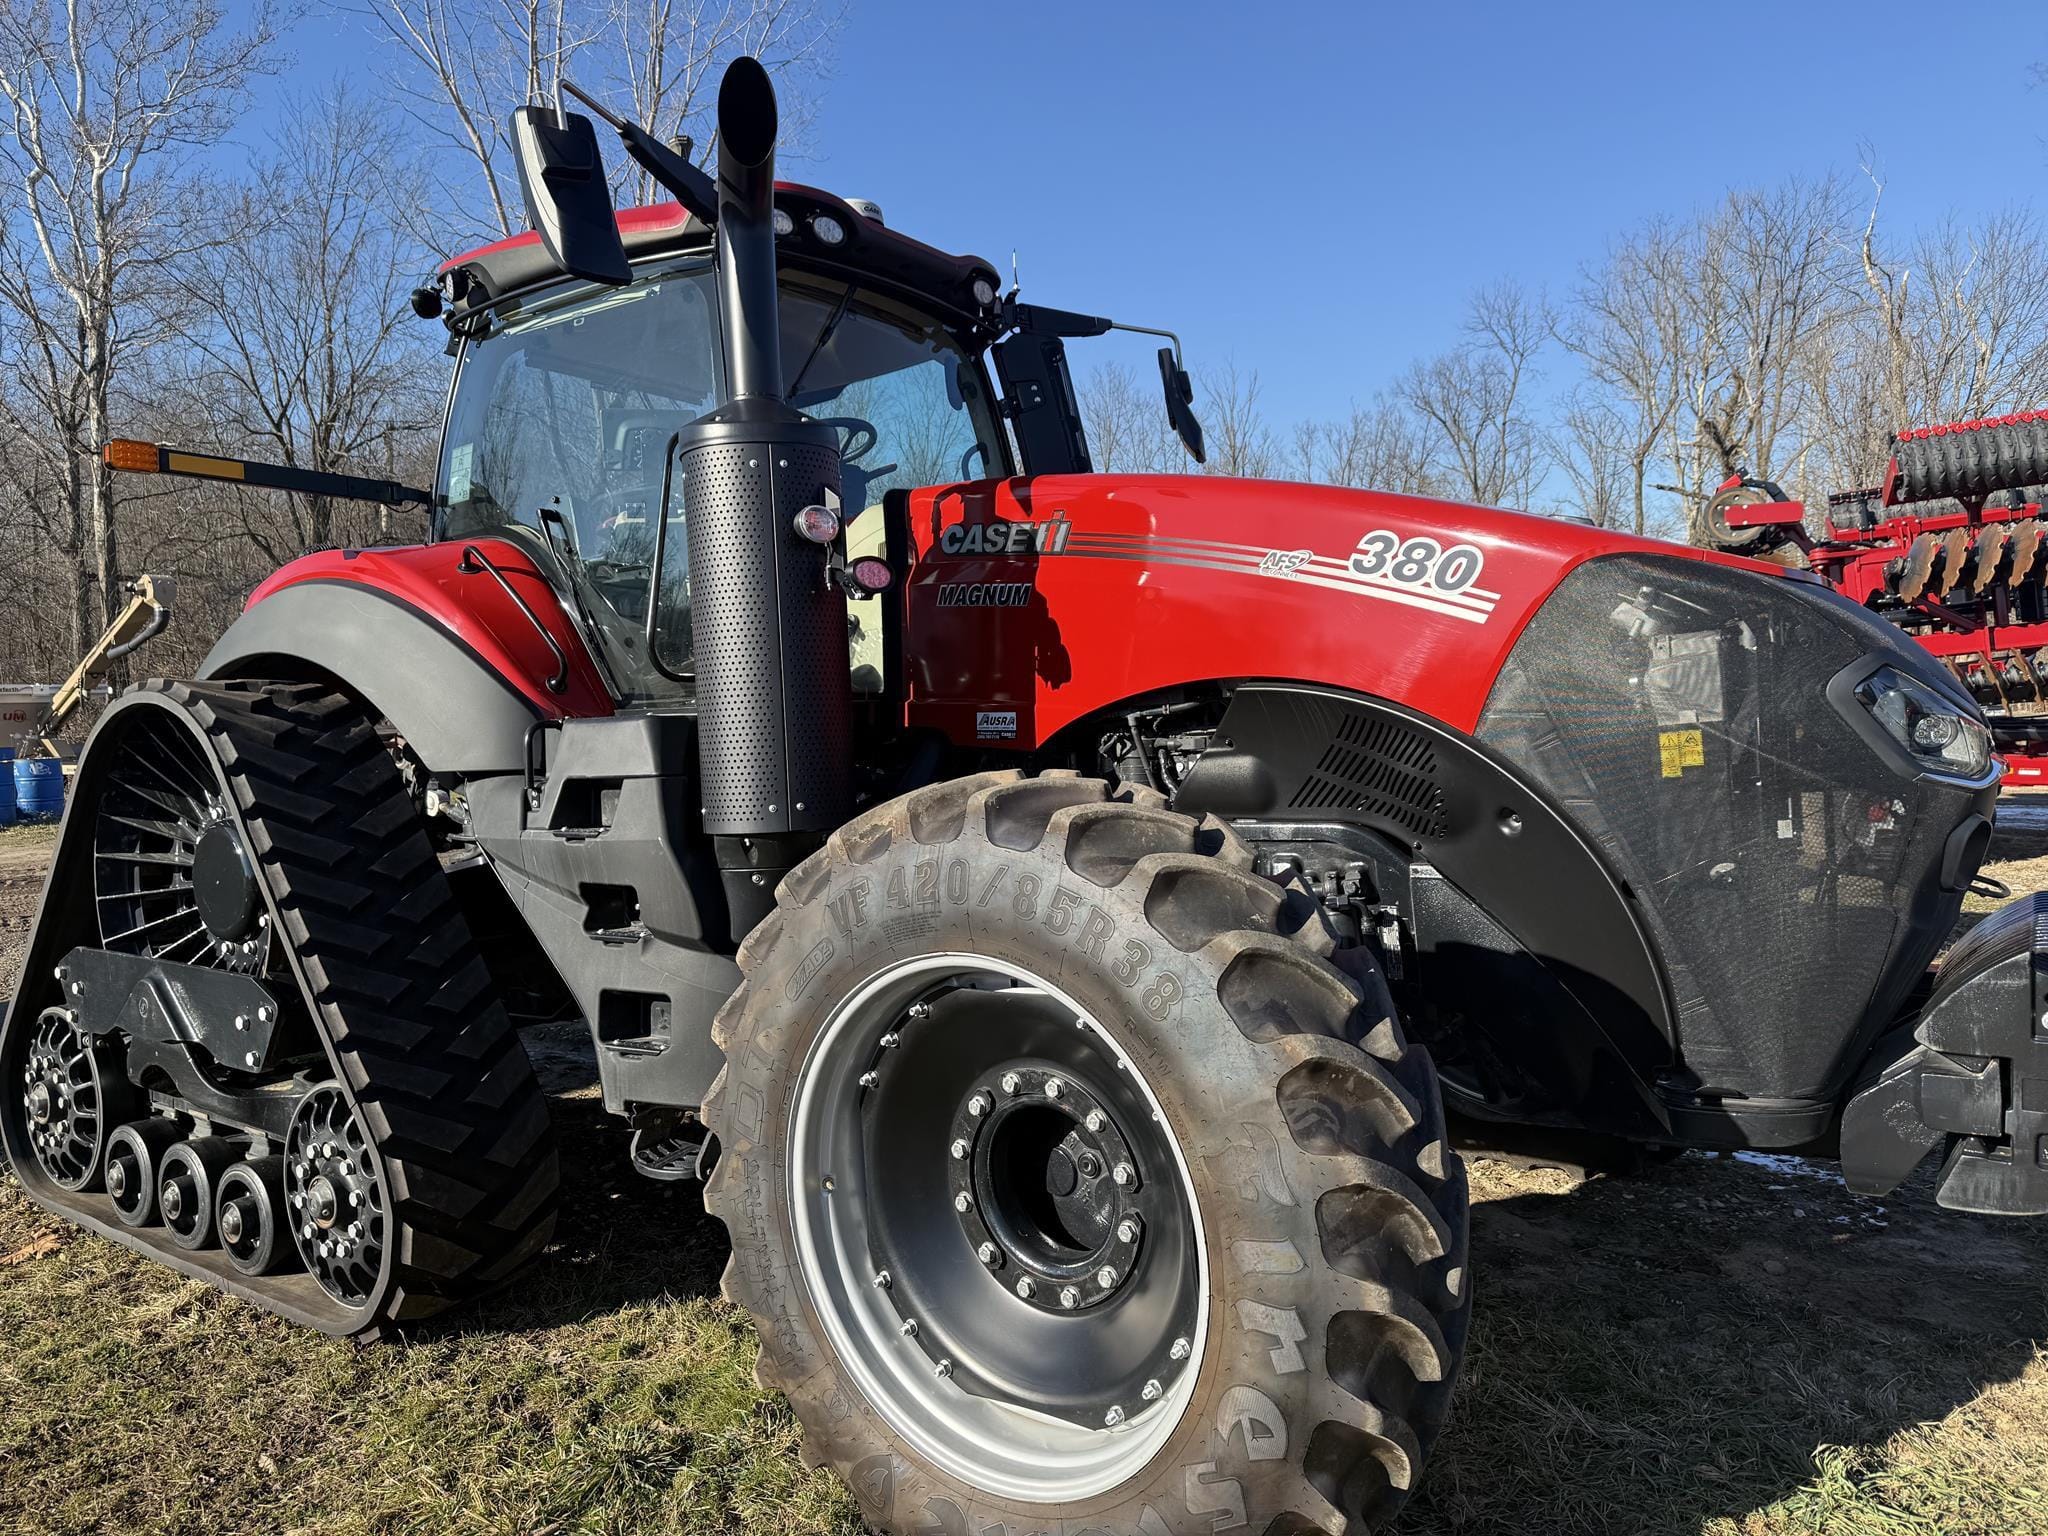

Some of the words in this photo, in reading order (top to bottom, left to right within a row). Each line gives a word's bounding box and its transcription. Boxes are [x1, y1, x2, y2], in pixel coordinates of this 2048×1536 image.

[941, 522, 1031, 554] CASE
[1035, 509, 1073, 555] IH
[1262, 551, 1301, 569] AFS
[1349, 529, 1484, 595] 380
[936, 583, 1032, 607] MAGNUM
[978, 713, 1015, 726] AUSRA
[826, 878, 870, 938] VF
[887, 858, 1184, 1022] 420/85R38
